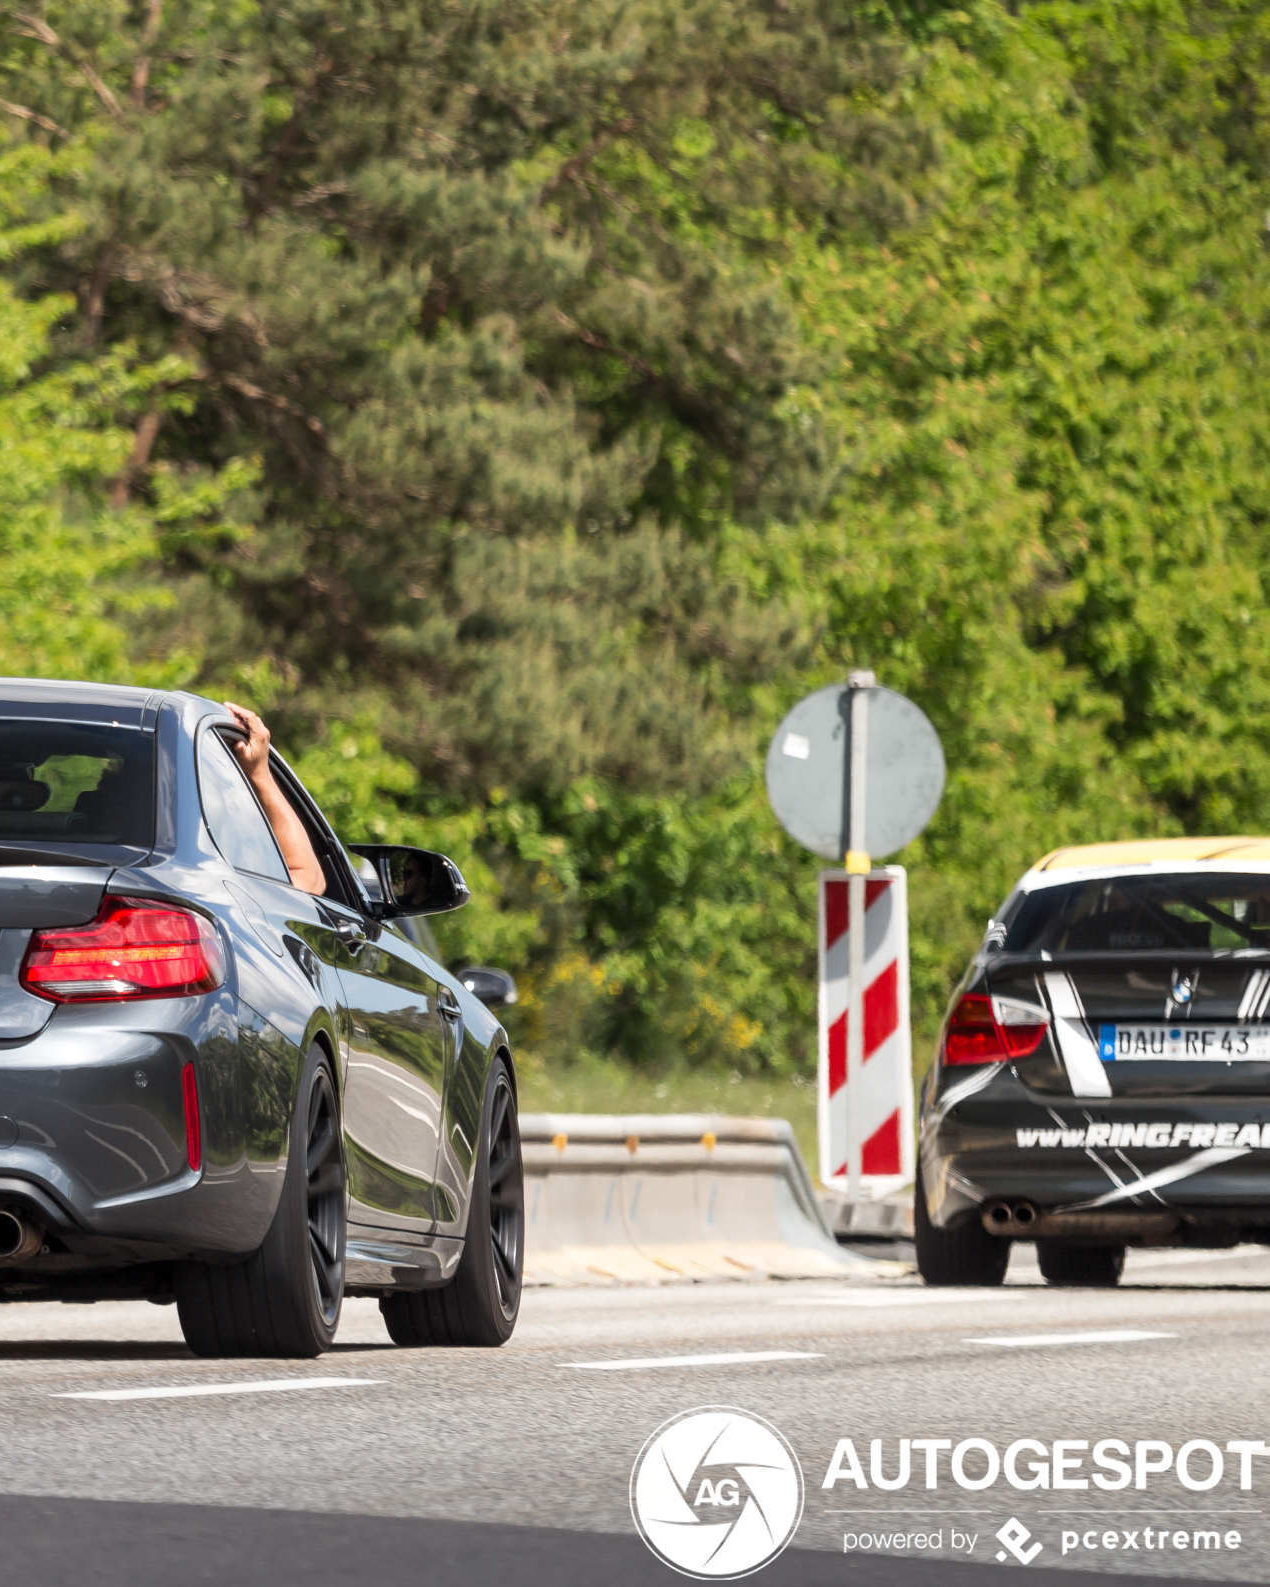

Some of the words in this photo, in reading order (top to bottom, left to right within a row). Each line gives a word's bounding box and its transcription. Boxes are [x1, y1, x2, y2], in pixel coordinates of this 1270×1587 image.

[1118, 1030, 1165, 1055] DAU
[1185, 1030, 1216, 1056] RF
[1221, 1030, 1250, 1055] 43
